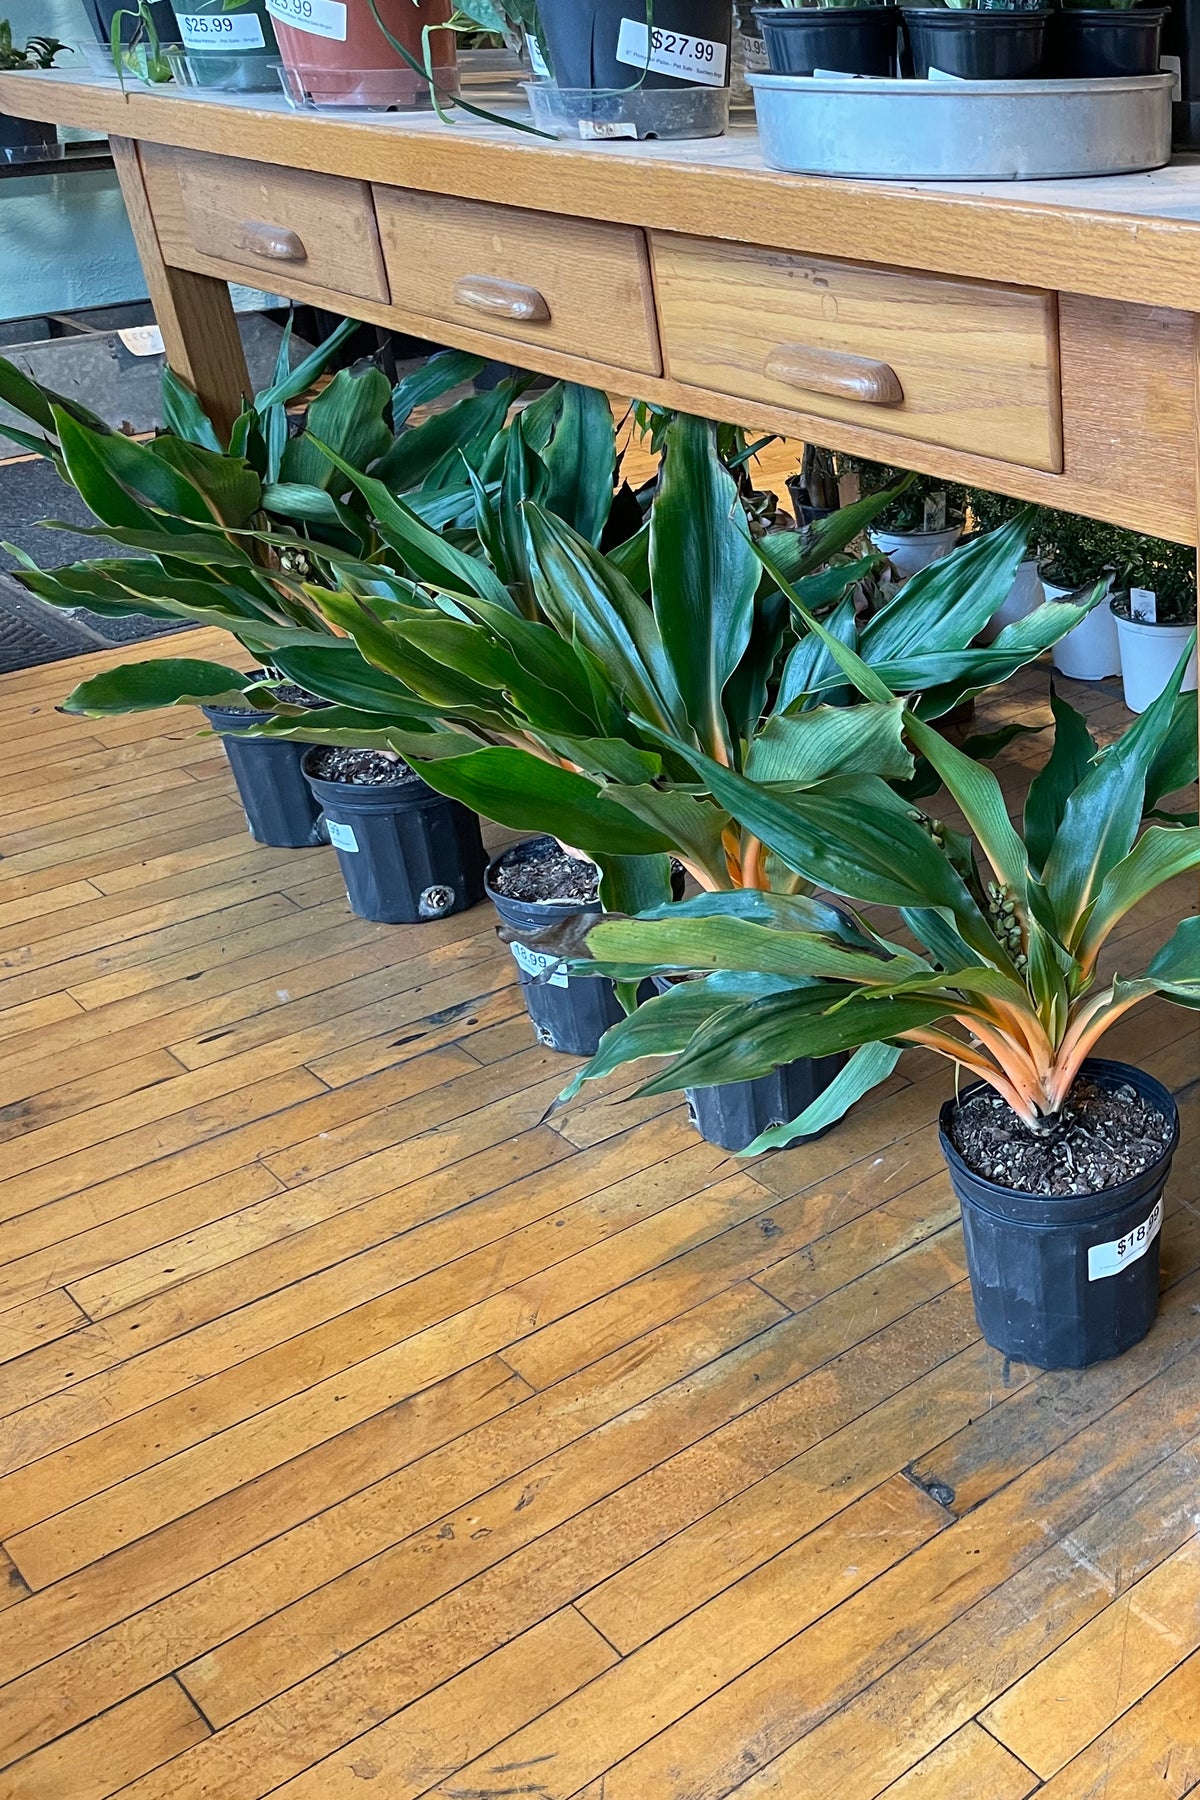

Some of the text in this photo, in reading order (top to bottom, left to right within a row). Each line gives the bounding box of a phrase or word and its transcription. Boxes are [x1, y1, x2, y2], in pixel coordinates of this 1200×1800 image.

[185, 16, 233, 34] $25.99
[651, 29, 714, 62] $27.99
[1117, 1205, 1160, 1257] $18.99
